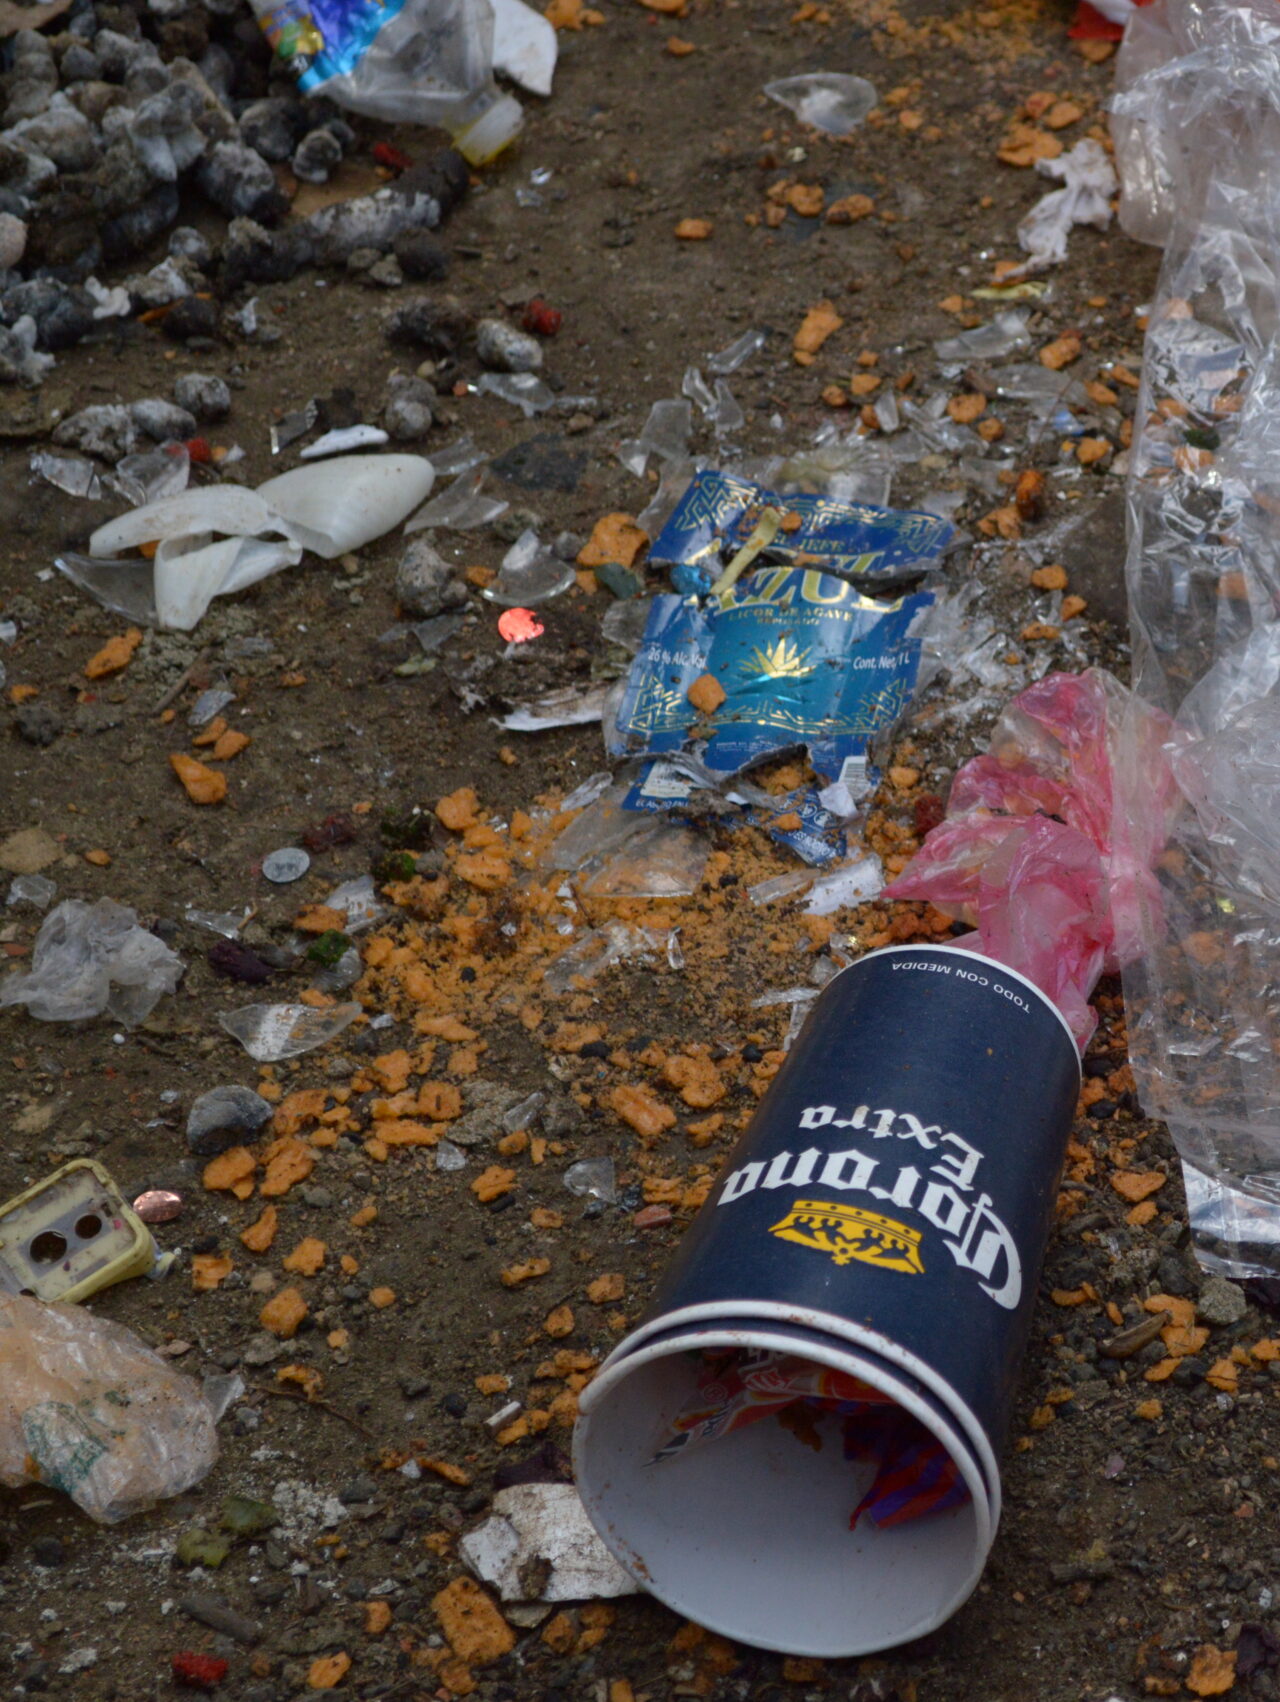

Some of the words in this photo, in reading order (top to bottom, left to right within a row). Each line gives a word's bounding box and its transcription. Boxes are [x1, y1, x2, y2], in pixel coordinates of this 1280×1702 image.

[803, 607, 854, 622] AGAVE
[891, 961, 952, 975] MEDIDA
[955, 969, 989, 987] CON
[993, 983, 1030, 1014] TODO
[799, 1104, 985, 1191] Extra
[717, 1147, 1022, 1310] Corona
